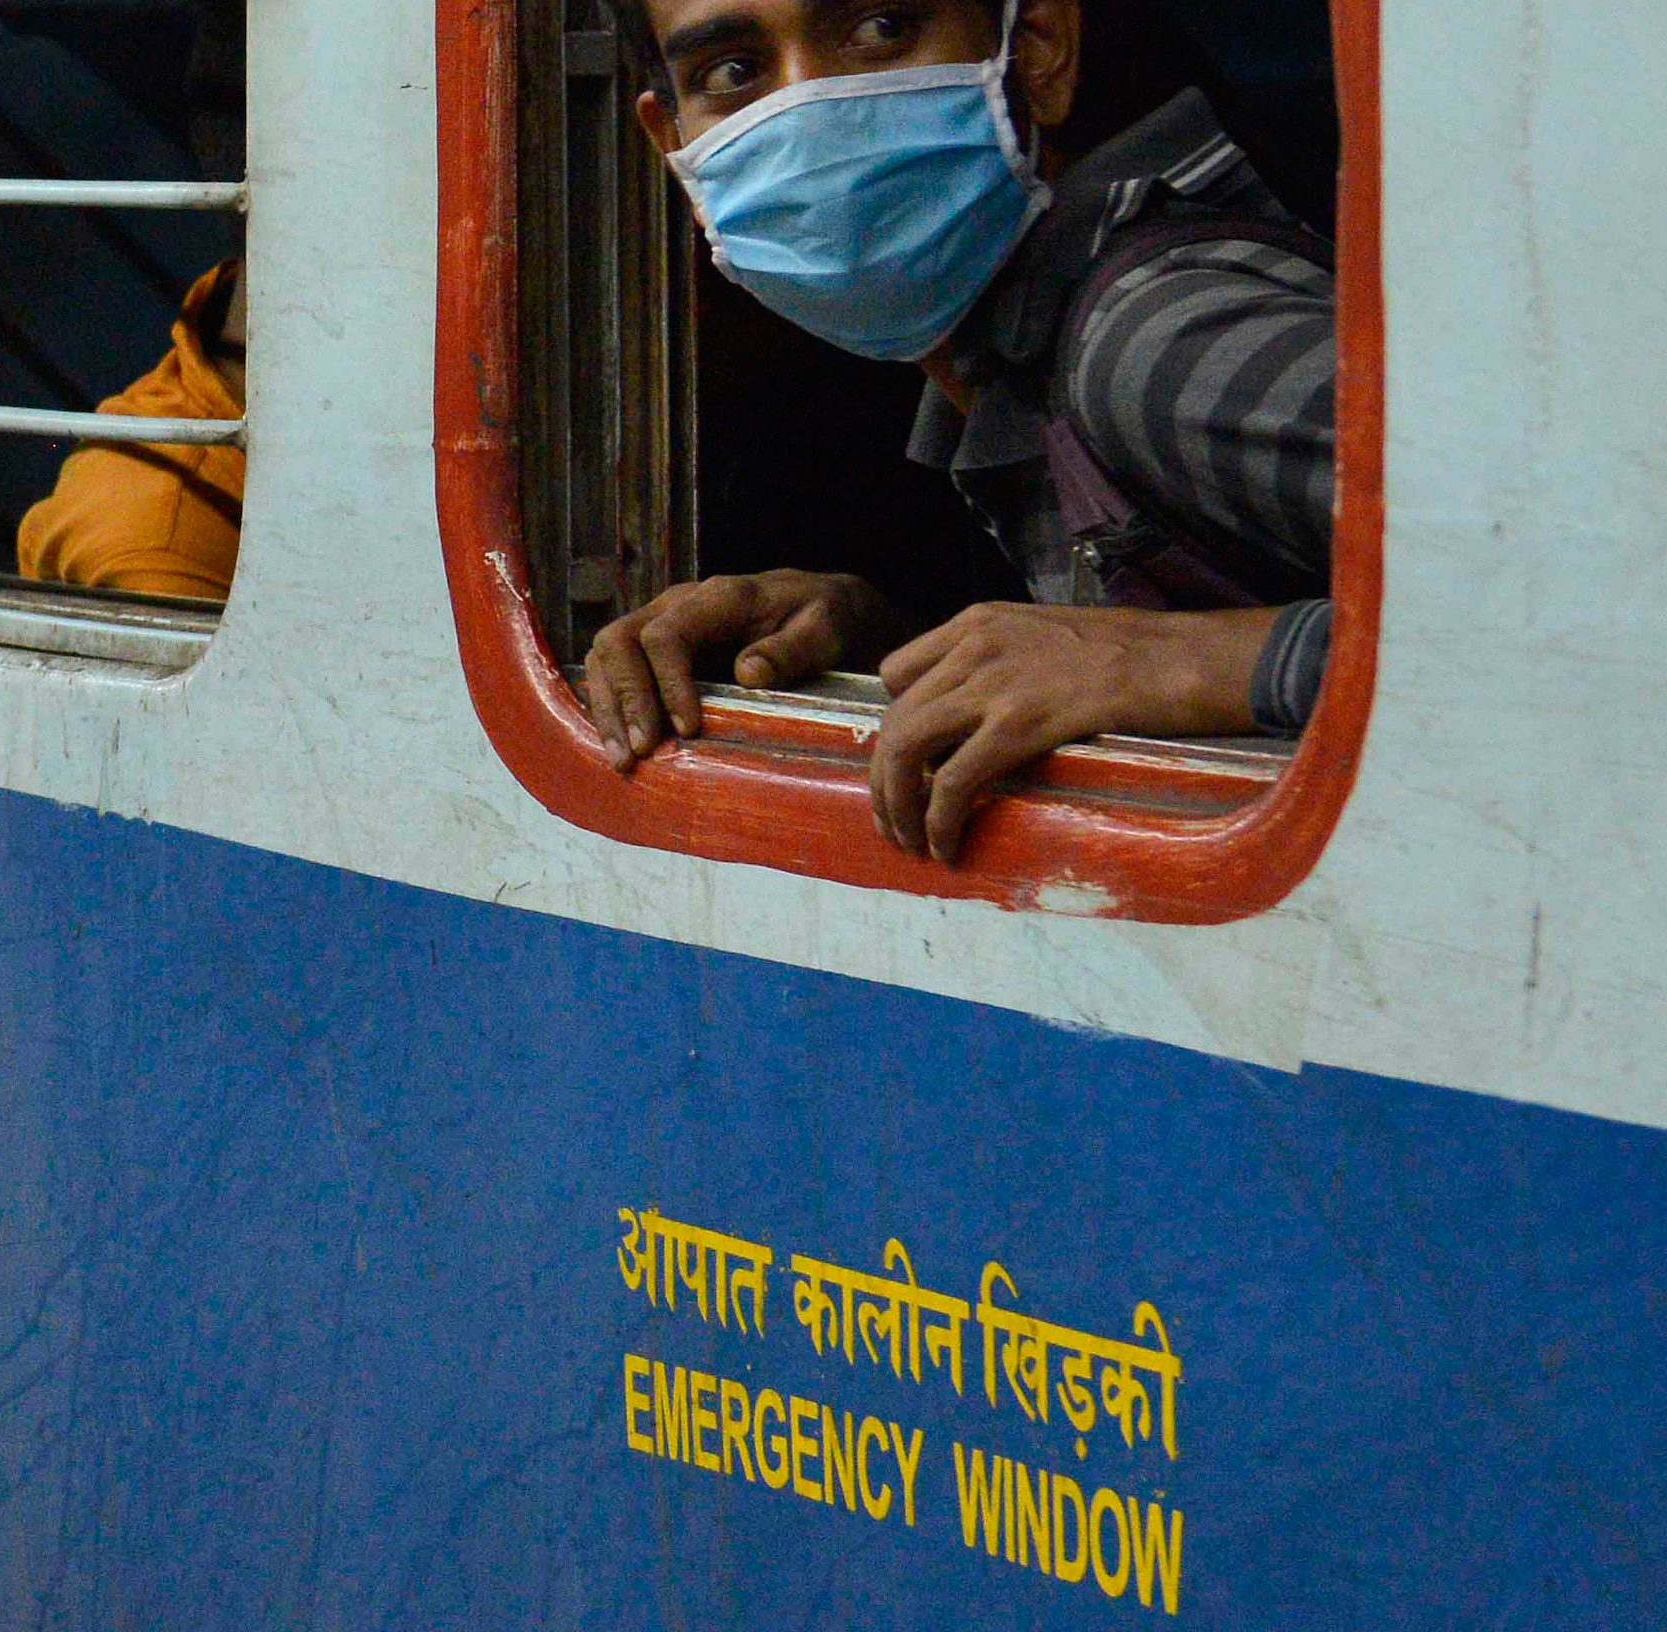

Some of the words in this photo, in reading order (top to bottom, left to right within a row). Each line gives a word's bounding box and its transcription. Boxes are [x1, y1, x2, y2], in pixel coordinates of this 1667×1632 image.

[617, 1206, 773, 1337] आपात
[790, 1237, 971, 1396] कालीन
[976, 1261, 1183, 1460] खिड़की
[624, 1353, 924, 1526] EMERGENCY
[953, 1442, 1184, 1615] WINDOW
